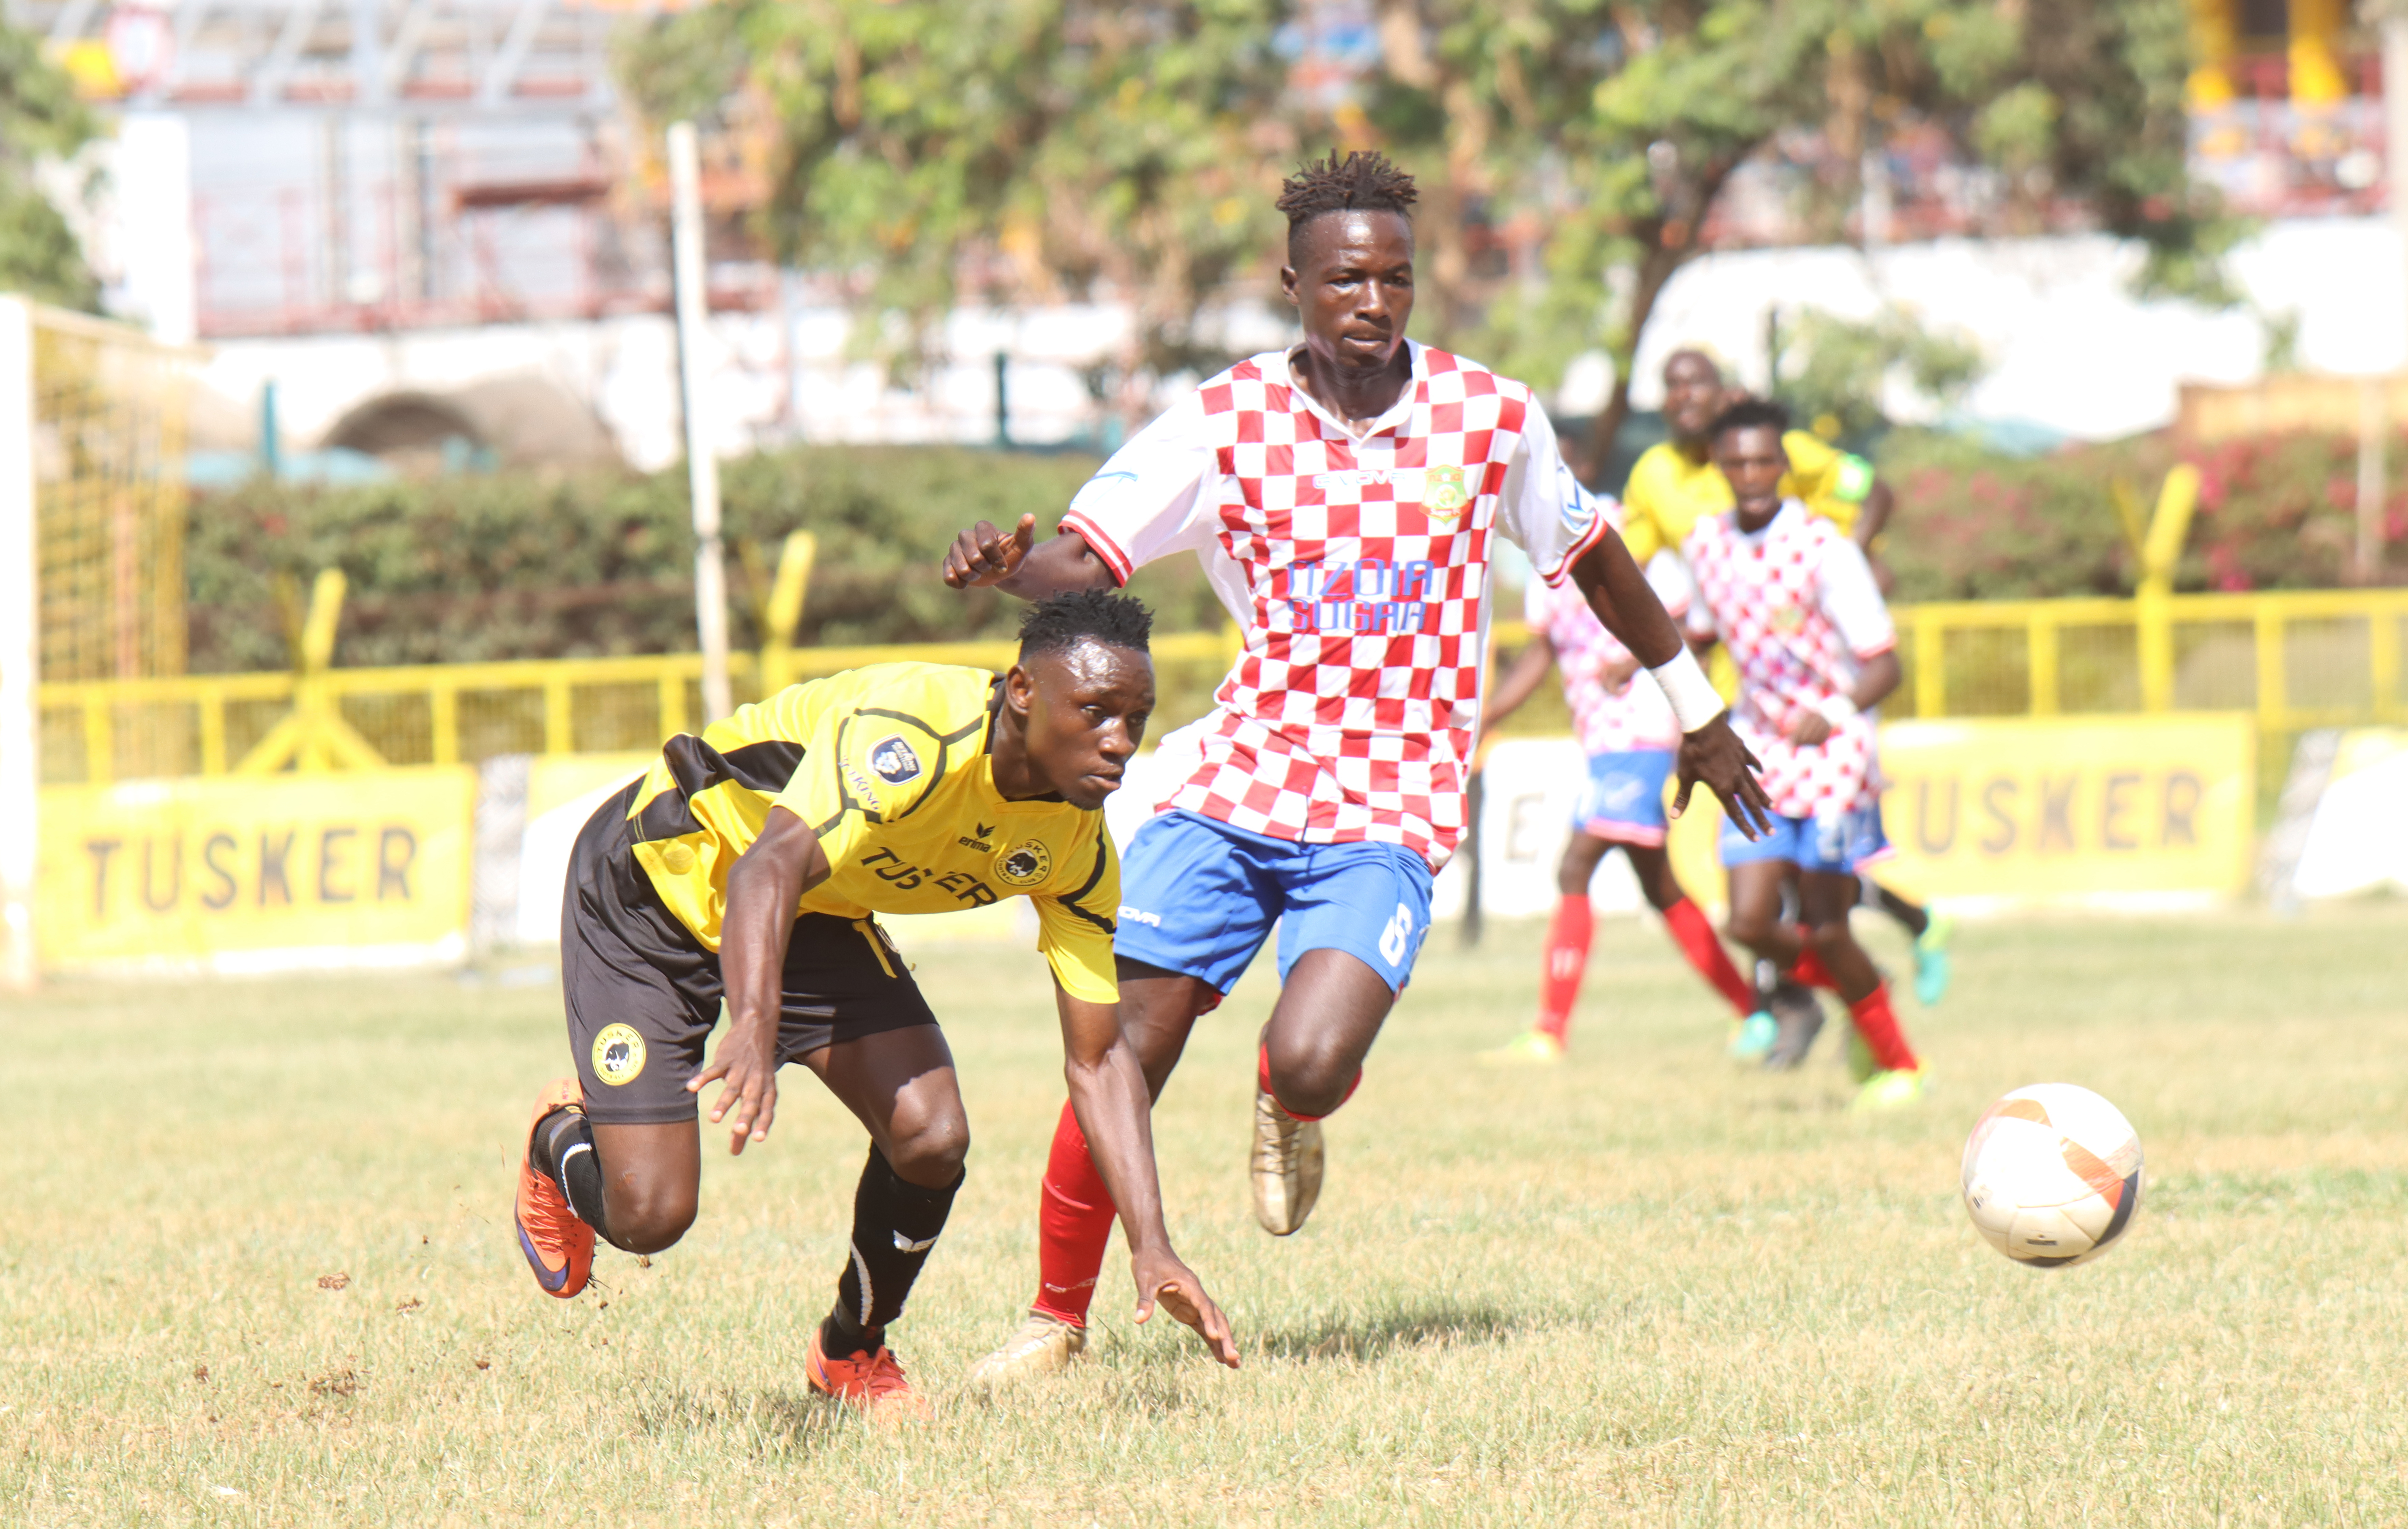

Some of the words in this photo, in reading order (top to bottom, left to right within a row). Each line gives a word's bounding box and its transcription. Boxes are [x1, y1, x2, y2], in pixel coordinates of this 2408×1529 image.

[1313, 470, 1406, 488] GVOVA
[1287, 599, 1426, 631] SUGAR
[1882, 771, 2204, 853] USKER
[85, 826, 416, 918] TUSKER
[958, 837, 991, 853] erima
[861, 847, 998, 908] TUSER
[1379, 902, 1412, 968] 6
